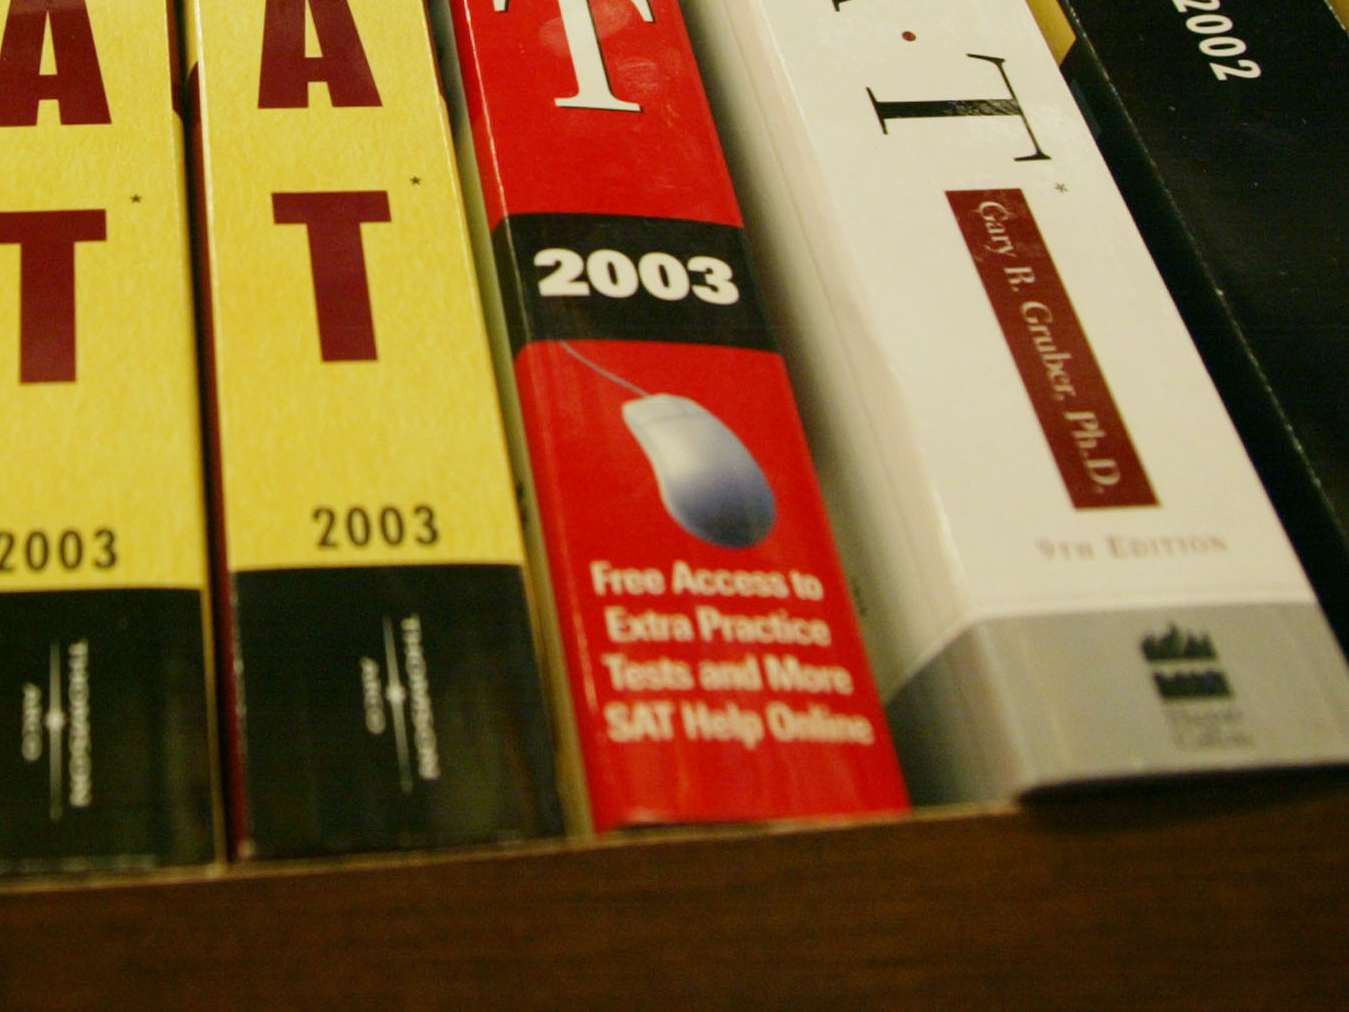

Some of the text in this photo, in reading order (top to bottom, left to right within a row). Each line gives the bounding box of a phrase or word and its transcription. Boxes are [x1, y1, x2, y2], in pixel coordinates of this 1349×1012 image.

[976, 200, 1017, 258] Gary
[533, 248, 740, 306] 2003
[311, 504, 441, 550] 2003
[590, 560, 824, 601] Free Access to
[604, 604, 832, 647] Extra Practice
[601, 653, 854, 695] Tests and More
[604, 700, 875, 751] SAT Help Online
